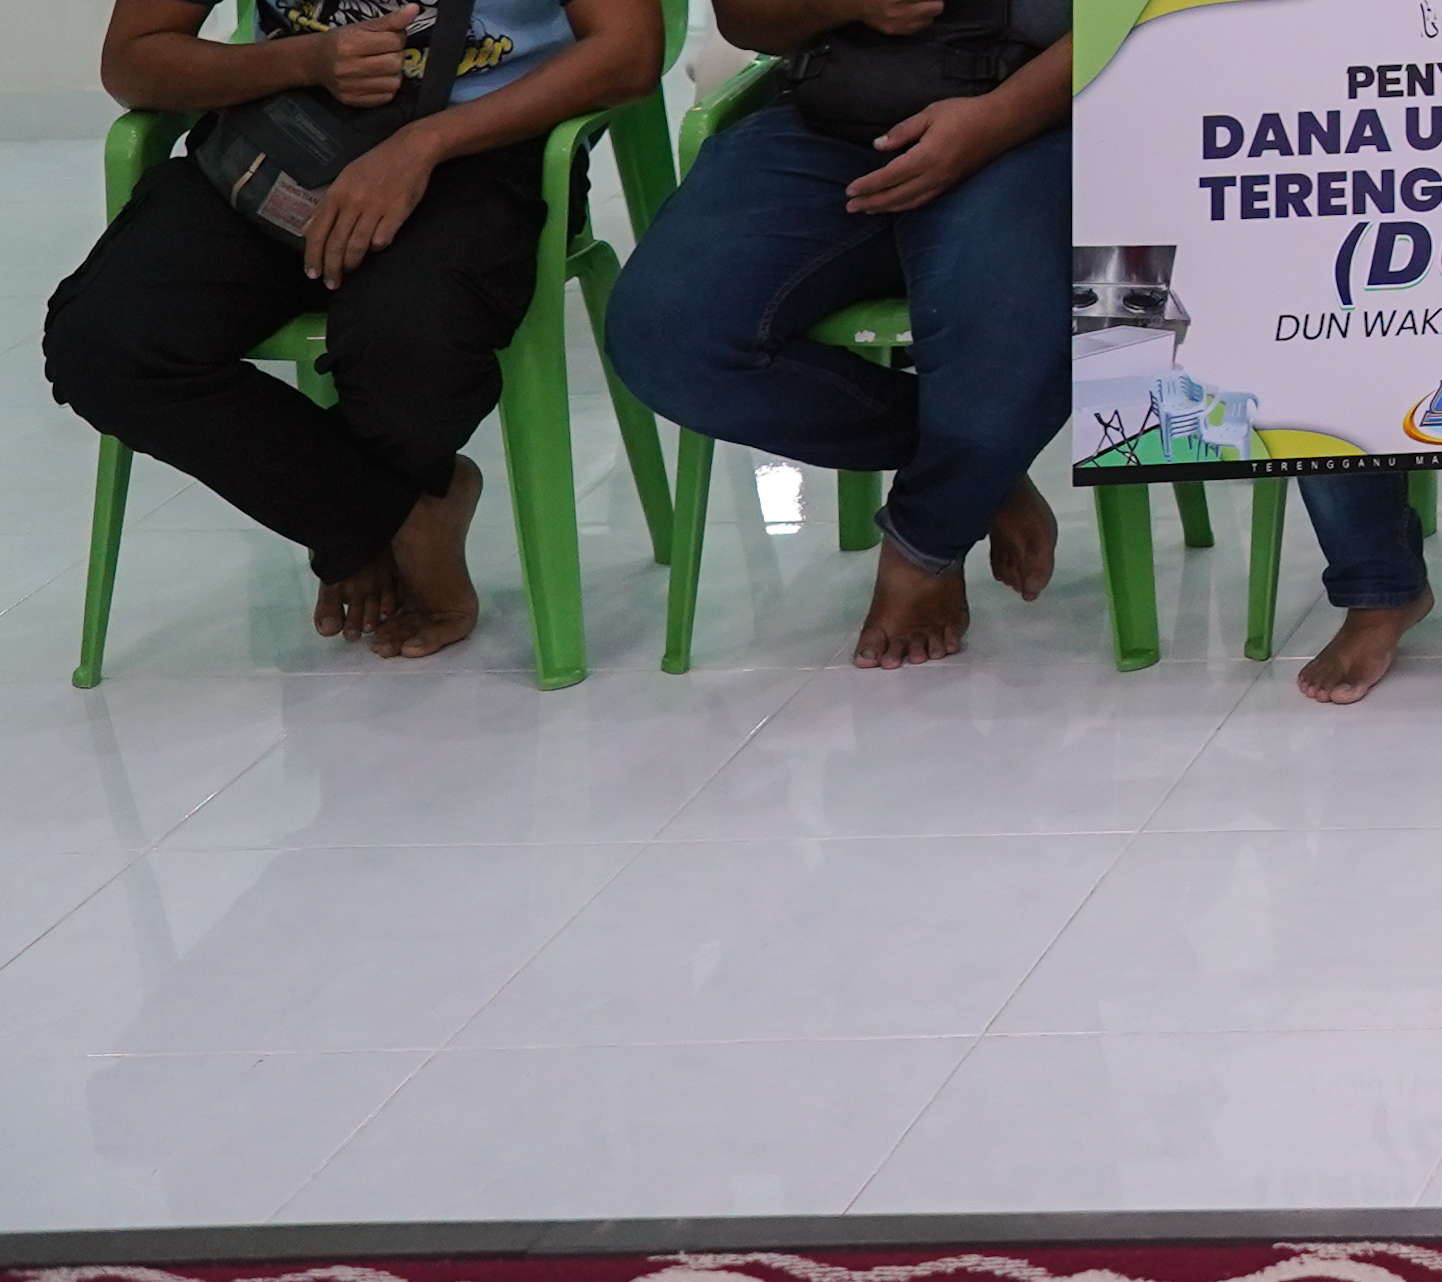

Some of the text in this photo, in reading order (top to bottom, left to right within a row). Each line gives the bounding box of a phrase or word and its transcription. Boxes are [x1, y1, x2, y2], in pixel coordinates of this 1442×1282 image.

[1202, 108, 1392, 160] DANA
[1275, 311, 1352, 342] DUN
[1251, 457, 1397, 473] TERENGGANU
